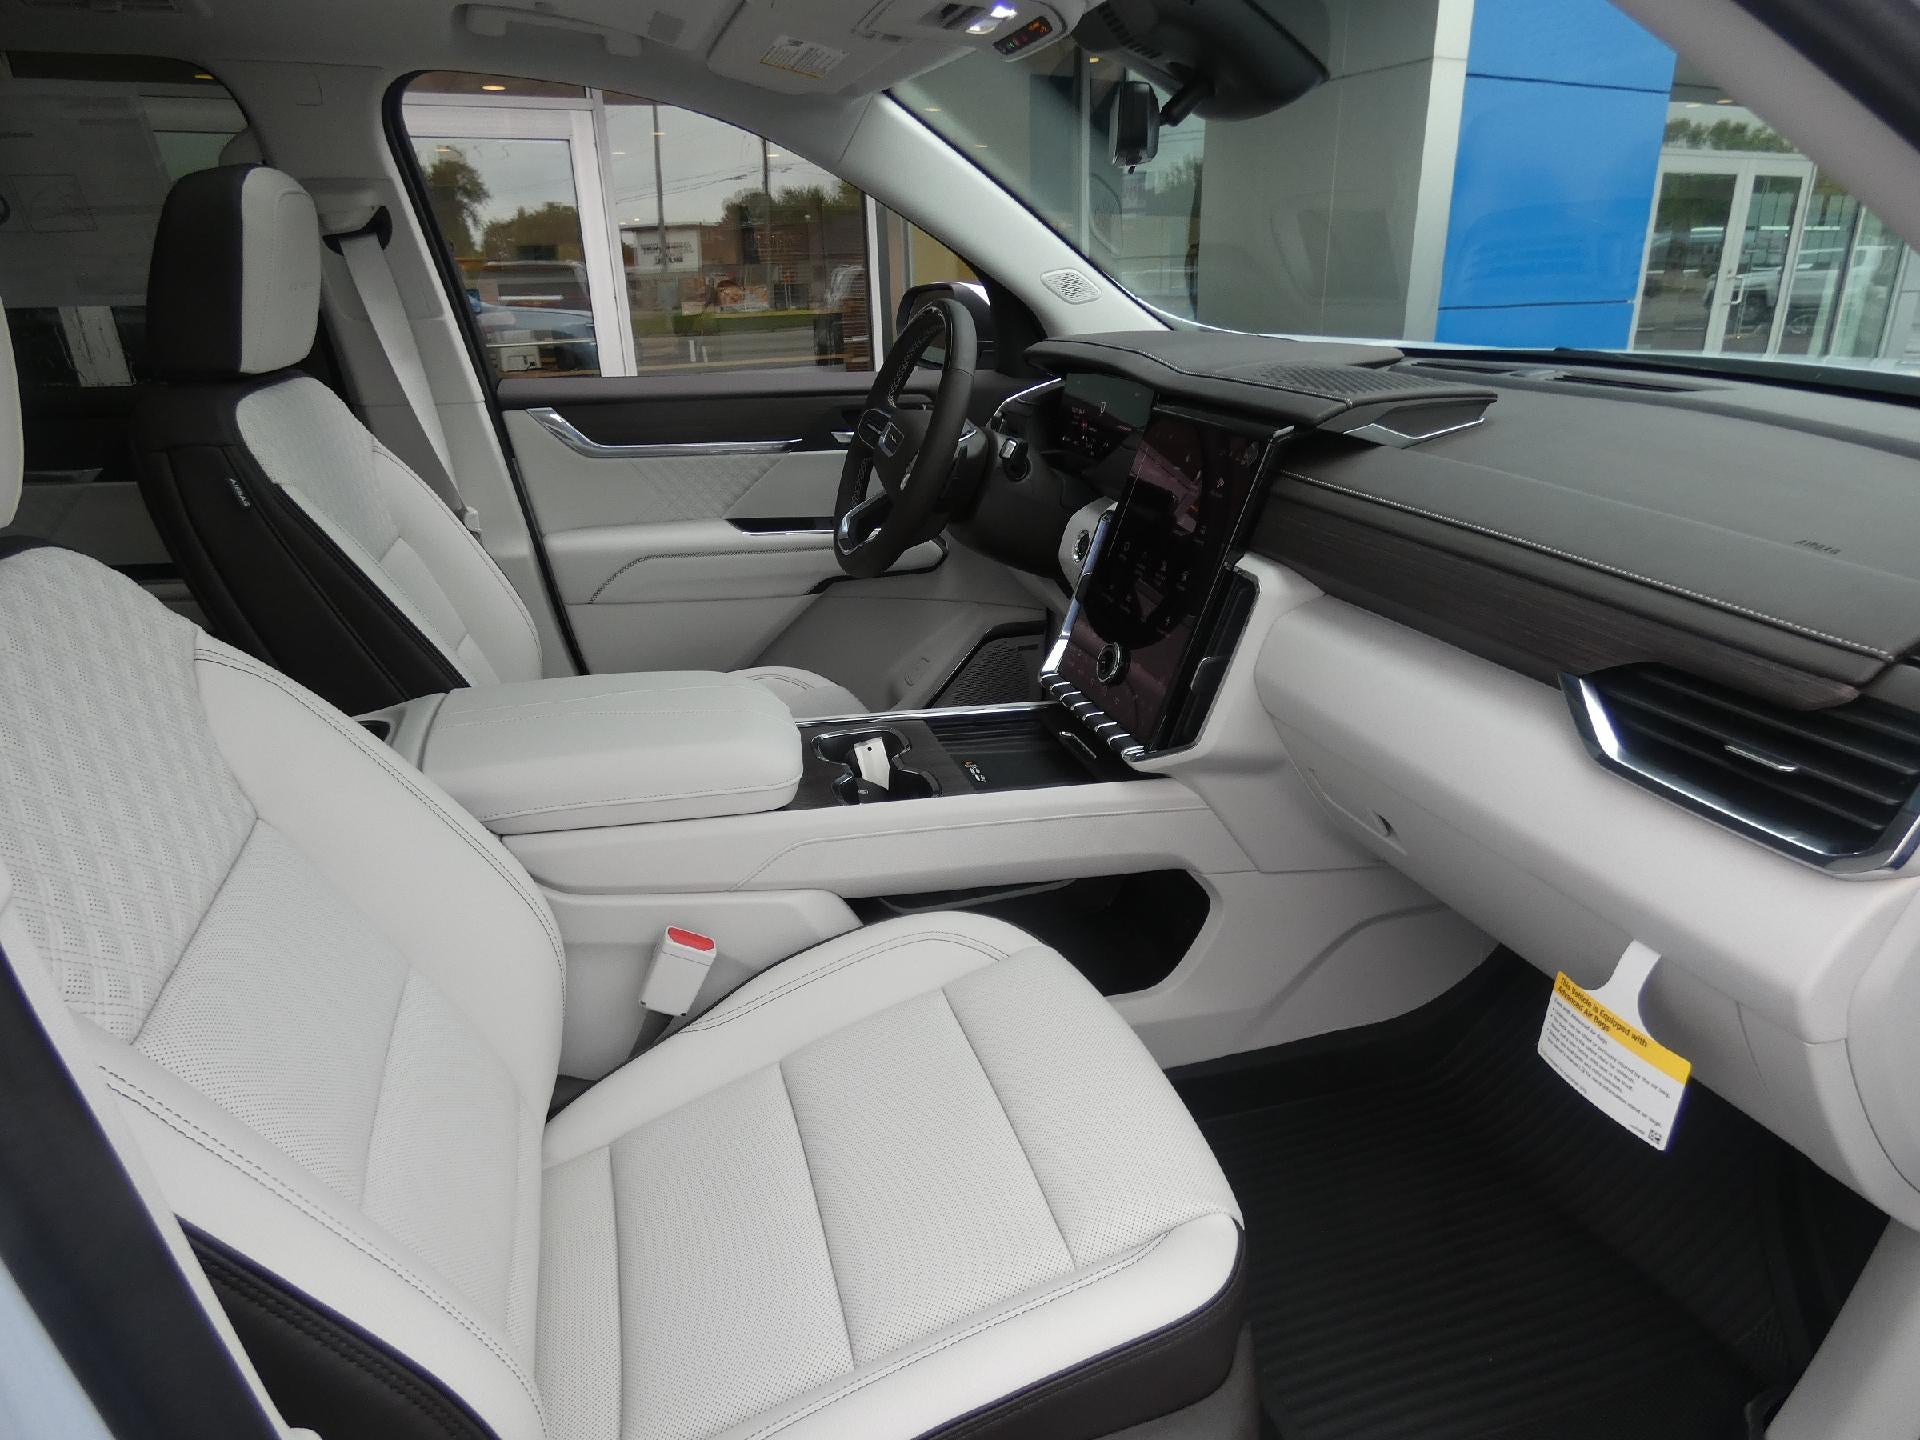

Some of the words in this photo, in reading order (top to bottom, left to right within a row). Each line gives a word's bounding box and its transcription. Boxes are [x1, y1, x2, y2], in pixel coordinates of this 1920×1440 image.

[1558, 986, 1583, 1011] Advanced
[1594, 1016, 1610, 1032] Bags
[1571, 987, 1592, 1007] Vehicle
[1600, 1010, 1630, 1036] Equipped
[1631, 1033, 1647, 1048] with
